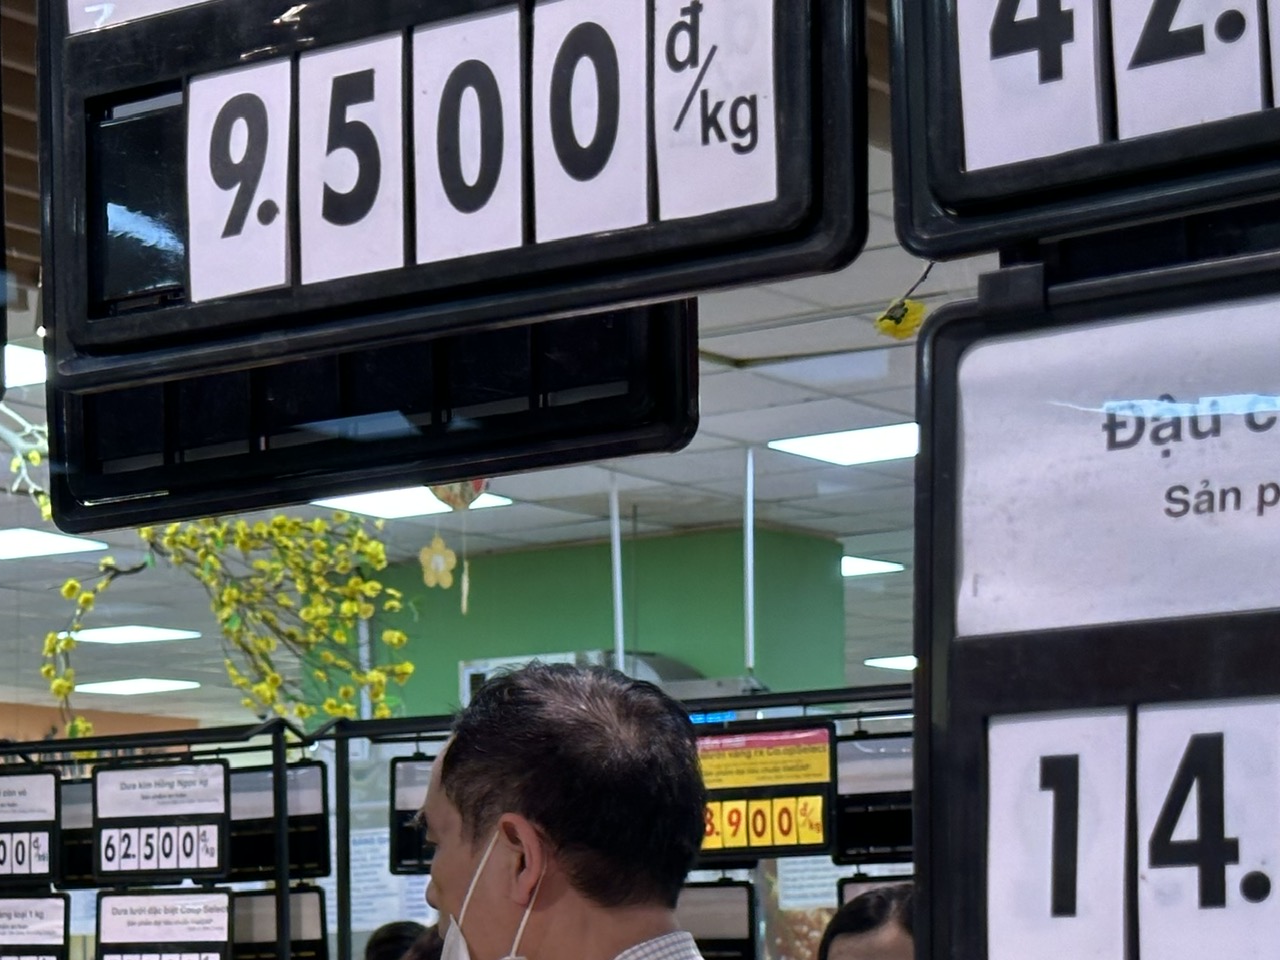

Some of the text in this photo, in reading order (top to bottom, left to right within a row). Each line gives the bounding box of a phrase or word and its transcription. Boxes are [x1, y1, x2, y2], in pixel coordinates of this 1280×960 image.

[209, 21, 620, 239] 9.500
[1164, 479, 1242, 518] Sản
[104, 831, 194, 862] 62.500
[1039, 732, 1271, 918] 14.
